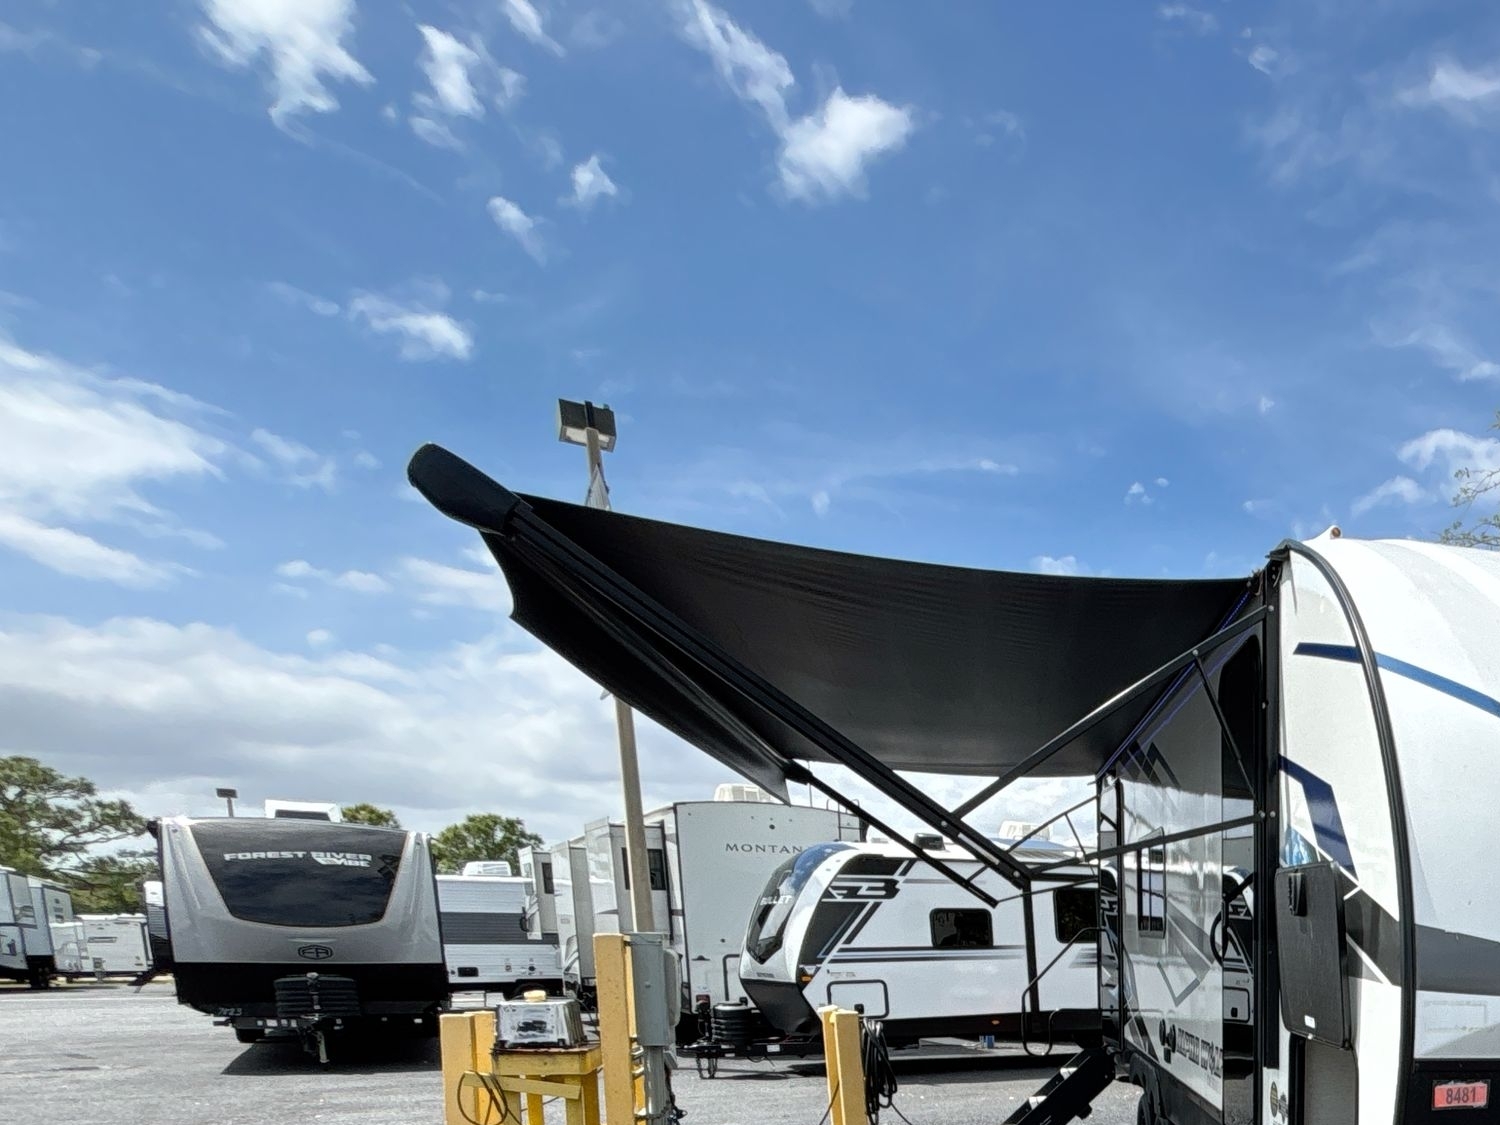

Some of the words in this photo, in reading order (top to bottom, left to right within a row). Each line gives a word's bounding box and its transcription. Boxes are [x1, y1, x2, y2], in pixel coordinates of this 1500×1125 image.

[725, 842, 803, 854] MONTAN
[223, 851, 306, 861] FOREST
[311, 851, 372, 861] RIVER
[1446, 1086, 1477, 1104] 8481
